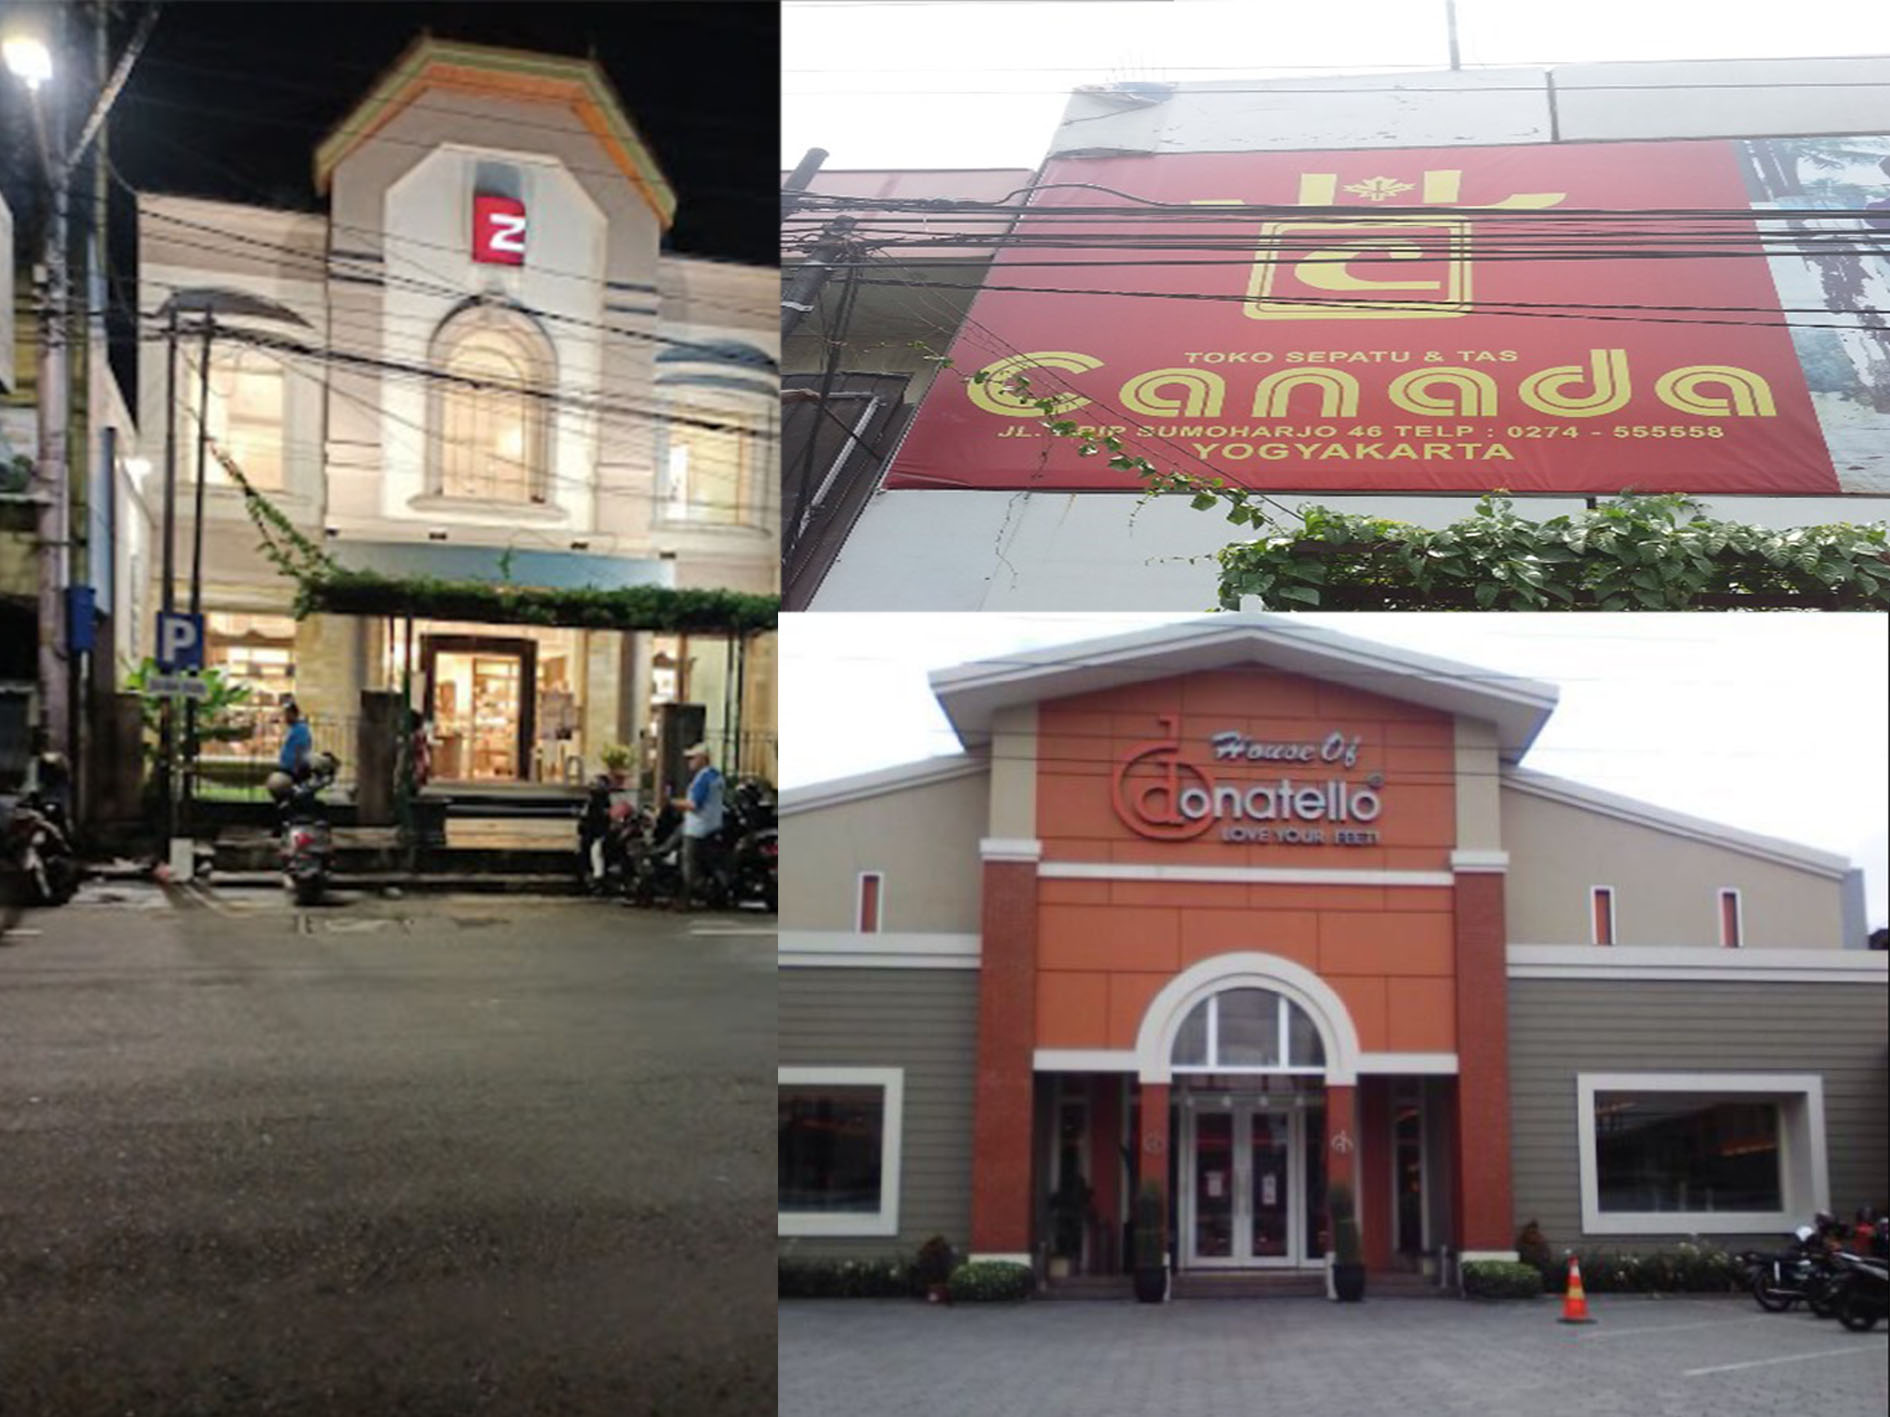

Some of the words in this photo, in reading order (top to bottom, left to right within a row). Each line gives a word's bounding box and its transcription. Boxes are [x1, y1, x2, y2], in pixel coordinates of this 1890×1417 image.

[1184, 351, 1274, 364] TOKO
[1285, 350, 1411, 364] SEPATU
[1423, 350, 1444, 363] &
[1456, 350, 1519, 363] TAS
[966, 347, 1778, 418] Canada
[997, 426, 1041, 438] JL.
[1136, 425, 1337, 438] SUMOHARJO
[1346, 425, 1383, 438] 46
[1393, 425, 1475, 438] TELP
[1507, 426, 1579, 438] 0274
[1613, 425, 1725, 438] 555558
[1192, 443, 1515, 460] YOGYAKARTA
[163, 619, 197, 662] P
[1212, 730, 1316, 761] House
[1321, 732, 1361, 767] Of
[1221, 827, 1270, 843] LOVE
[1275, 827, 1325, 843] YOUR
